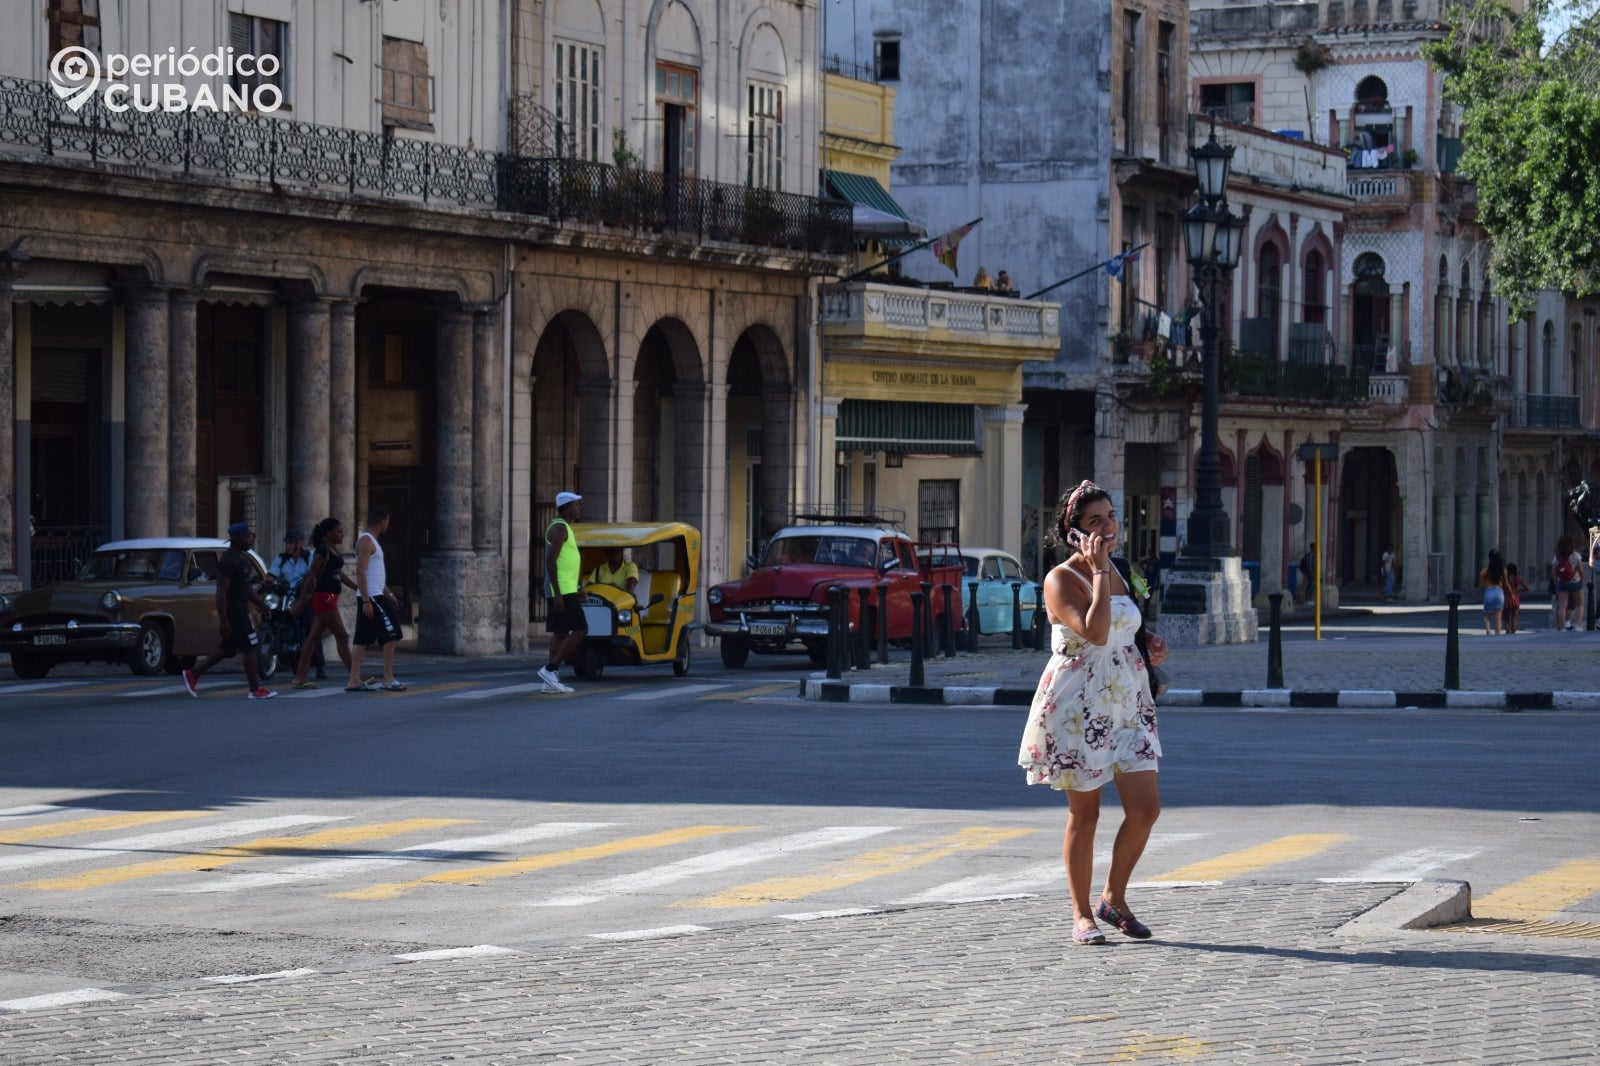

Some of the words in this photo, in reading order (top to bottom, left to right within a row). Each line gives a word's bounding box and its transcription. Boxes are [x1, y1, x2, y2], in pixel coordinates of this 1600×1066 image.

[872, 371, 897, 383] CENTRO
[900, 372, 928, 384] ANDALUZ
[931, 373, 938, 384] DE
[940, 374, 949, 385] LA
[951, 374, 976, 385] HABANA
